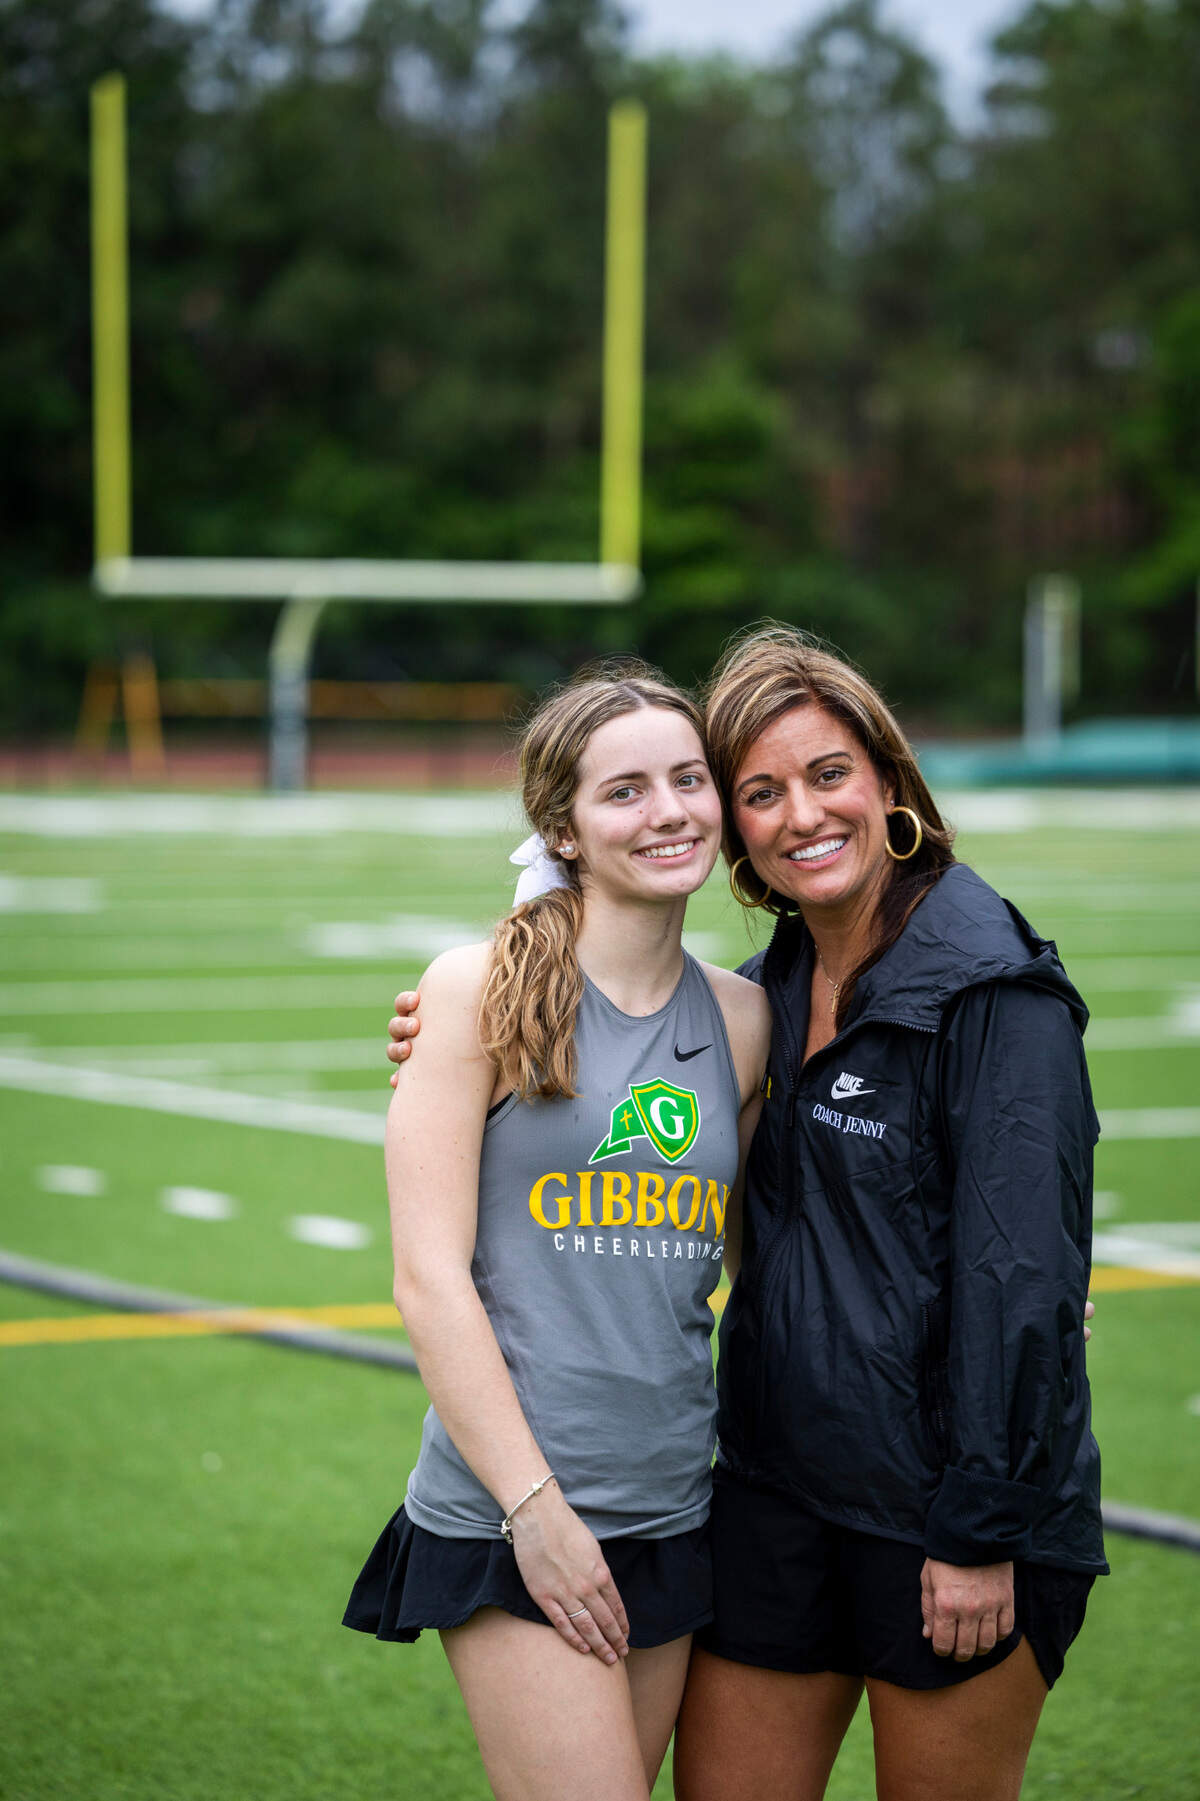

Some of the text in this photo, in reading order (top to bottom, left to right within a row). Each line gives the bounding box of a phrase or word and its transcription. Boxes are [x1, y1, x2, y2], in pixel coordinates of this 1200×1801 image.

[836, 1071, 865, 1092] NIKE
[650, 1096, 685, 1140] G
[812, 1103, 887, 1140] COACH JENNY
[529, 1171, 731, 1241] GIBBON
[554, 1233, 724, 1261] CHEERLEADING
